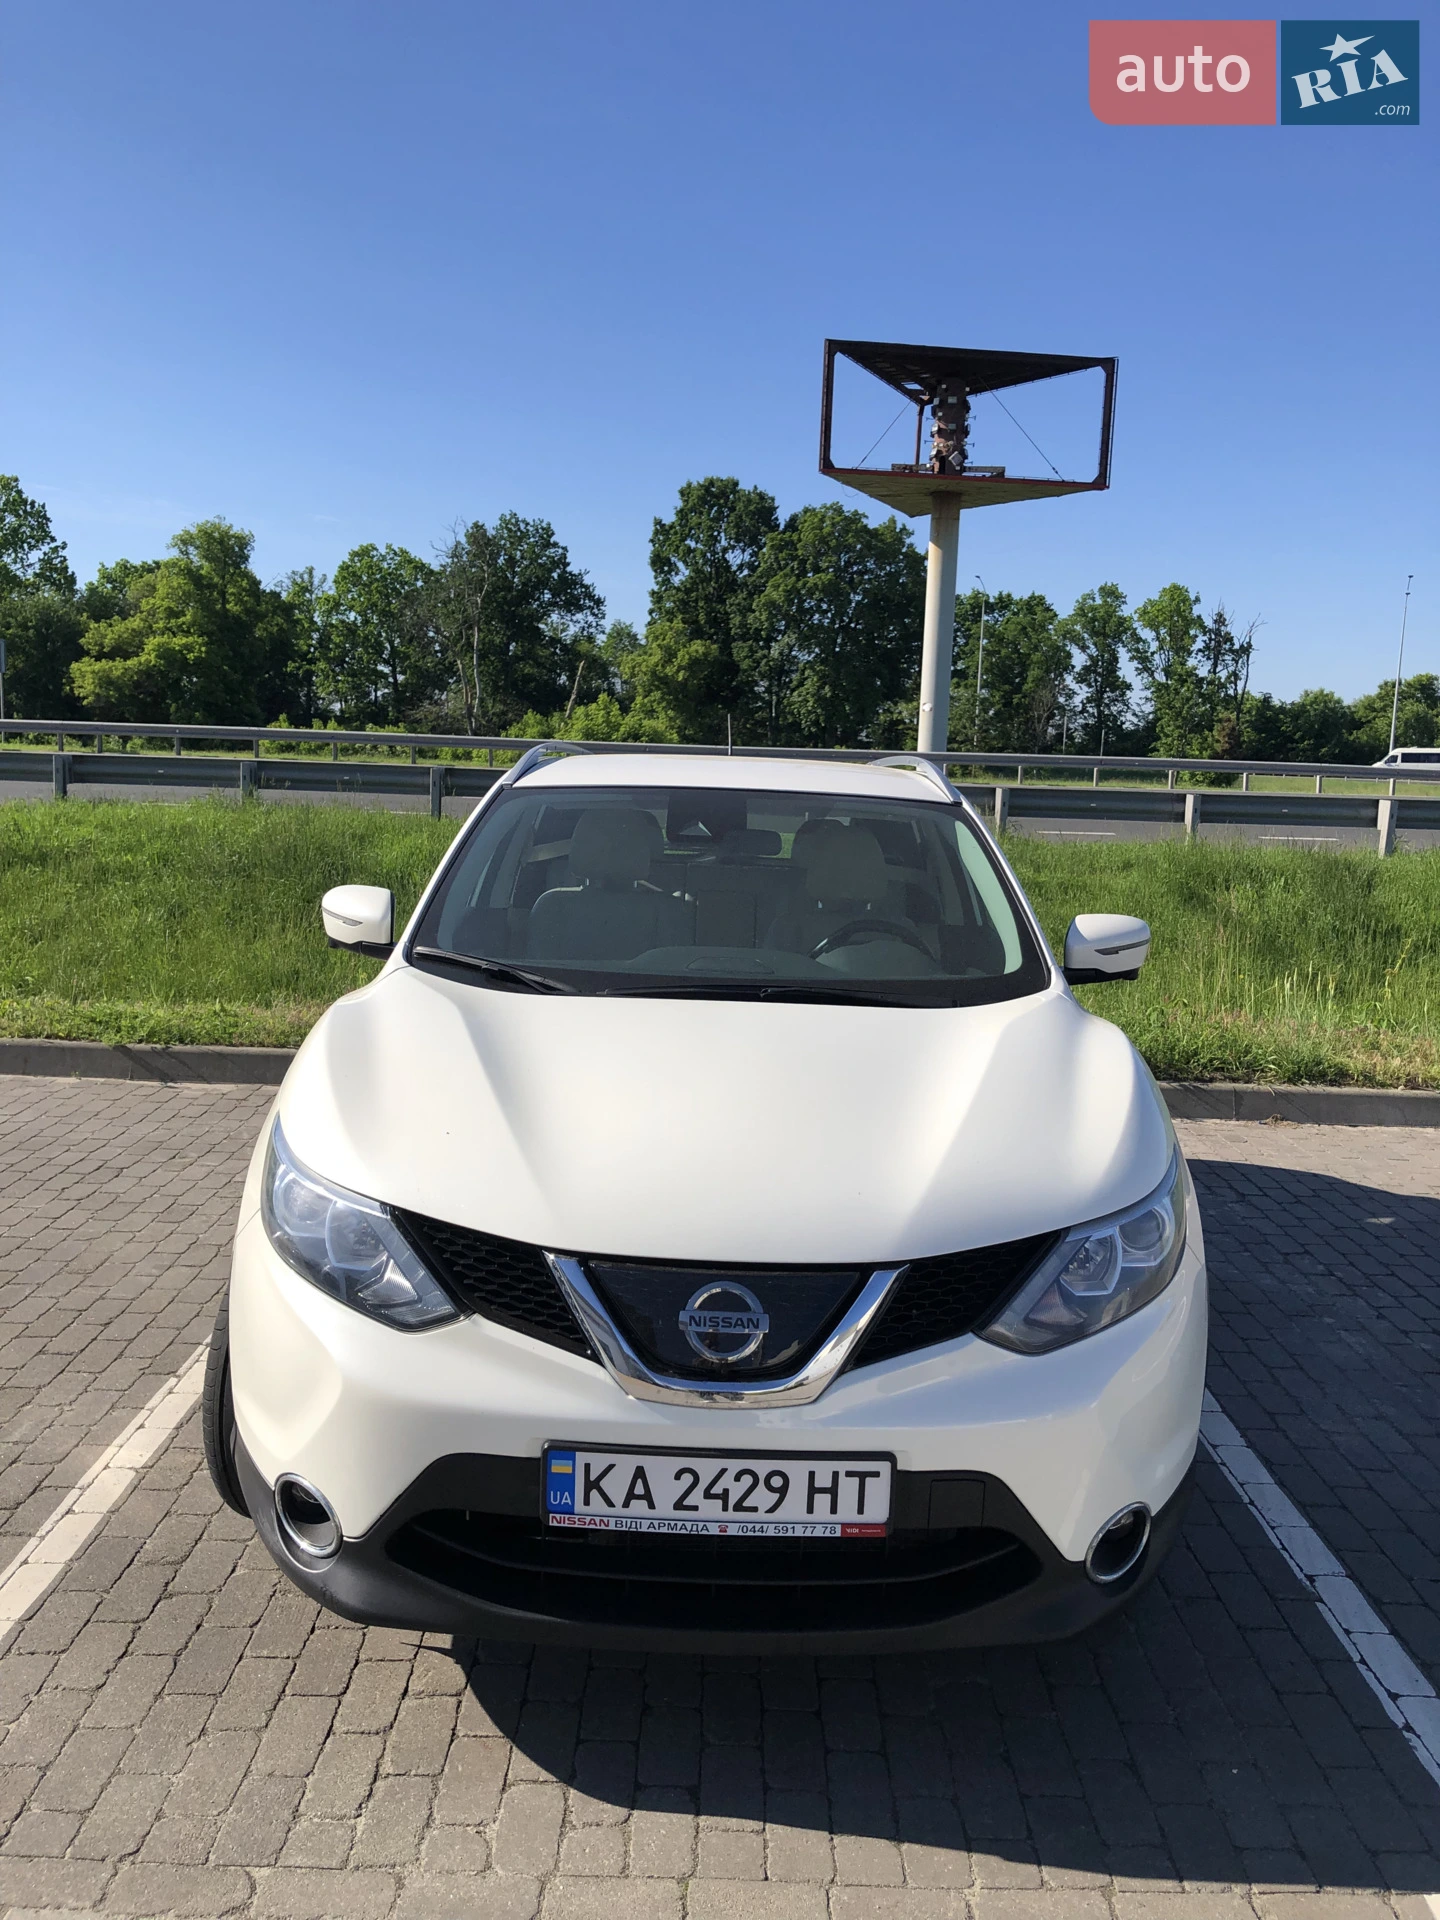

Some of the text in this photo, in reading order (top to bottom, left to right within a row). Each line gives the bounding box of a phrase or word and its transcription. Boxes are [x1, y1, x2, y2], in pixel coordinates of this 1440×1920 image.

[688, 1315, 760, 1330] NISSAN
[550, 1490, 572, 1505] UA
[582, 1462, 881, 1516] KA 2429 HT
[550, 1515, 837, 1535] NISSAN ВІДІ АРМАДА /044/ 591 77 78
